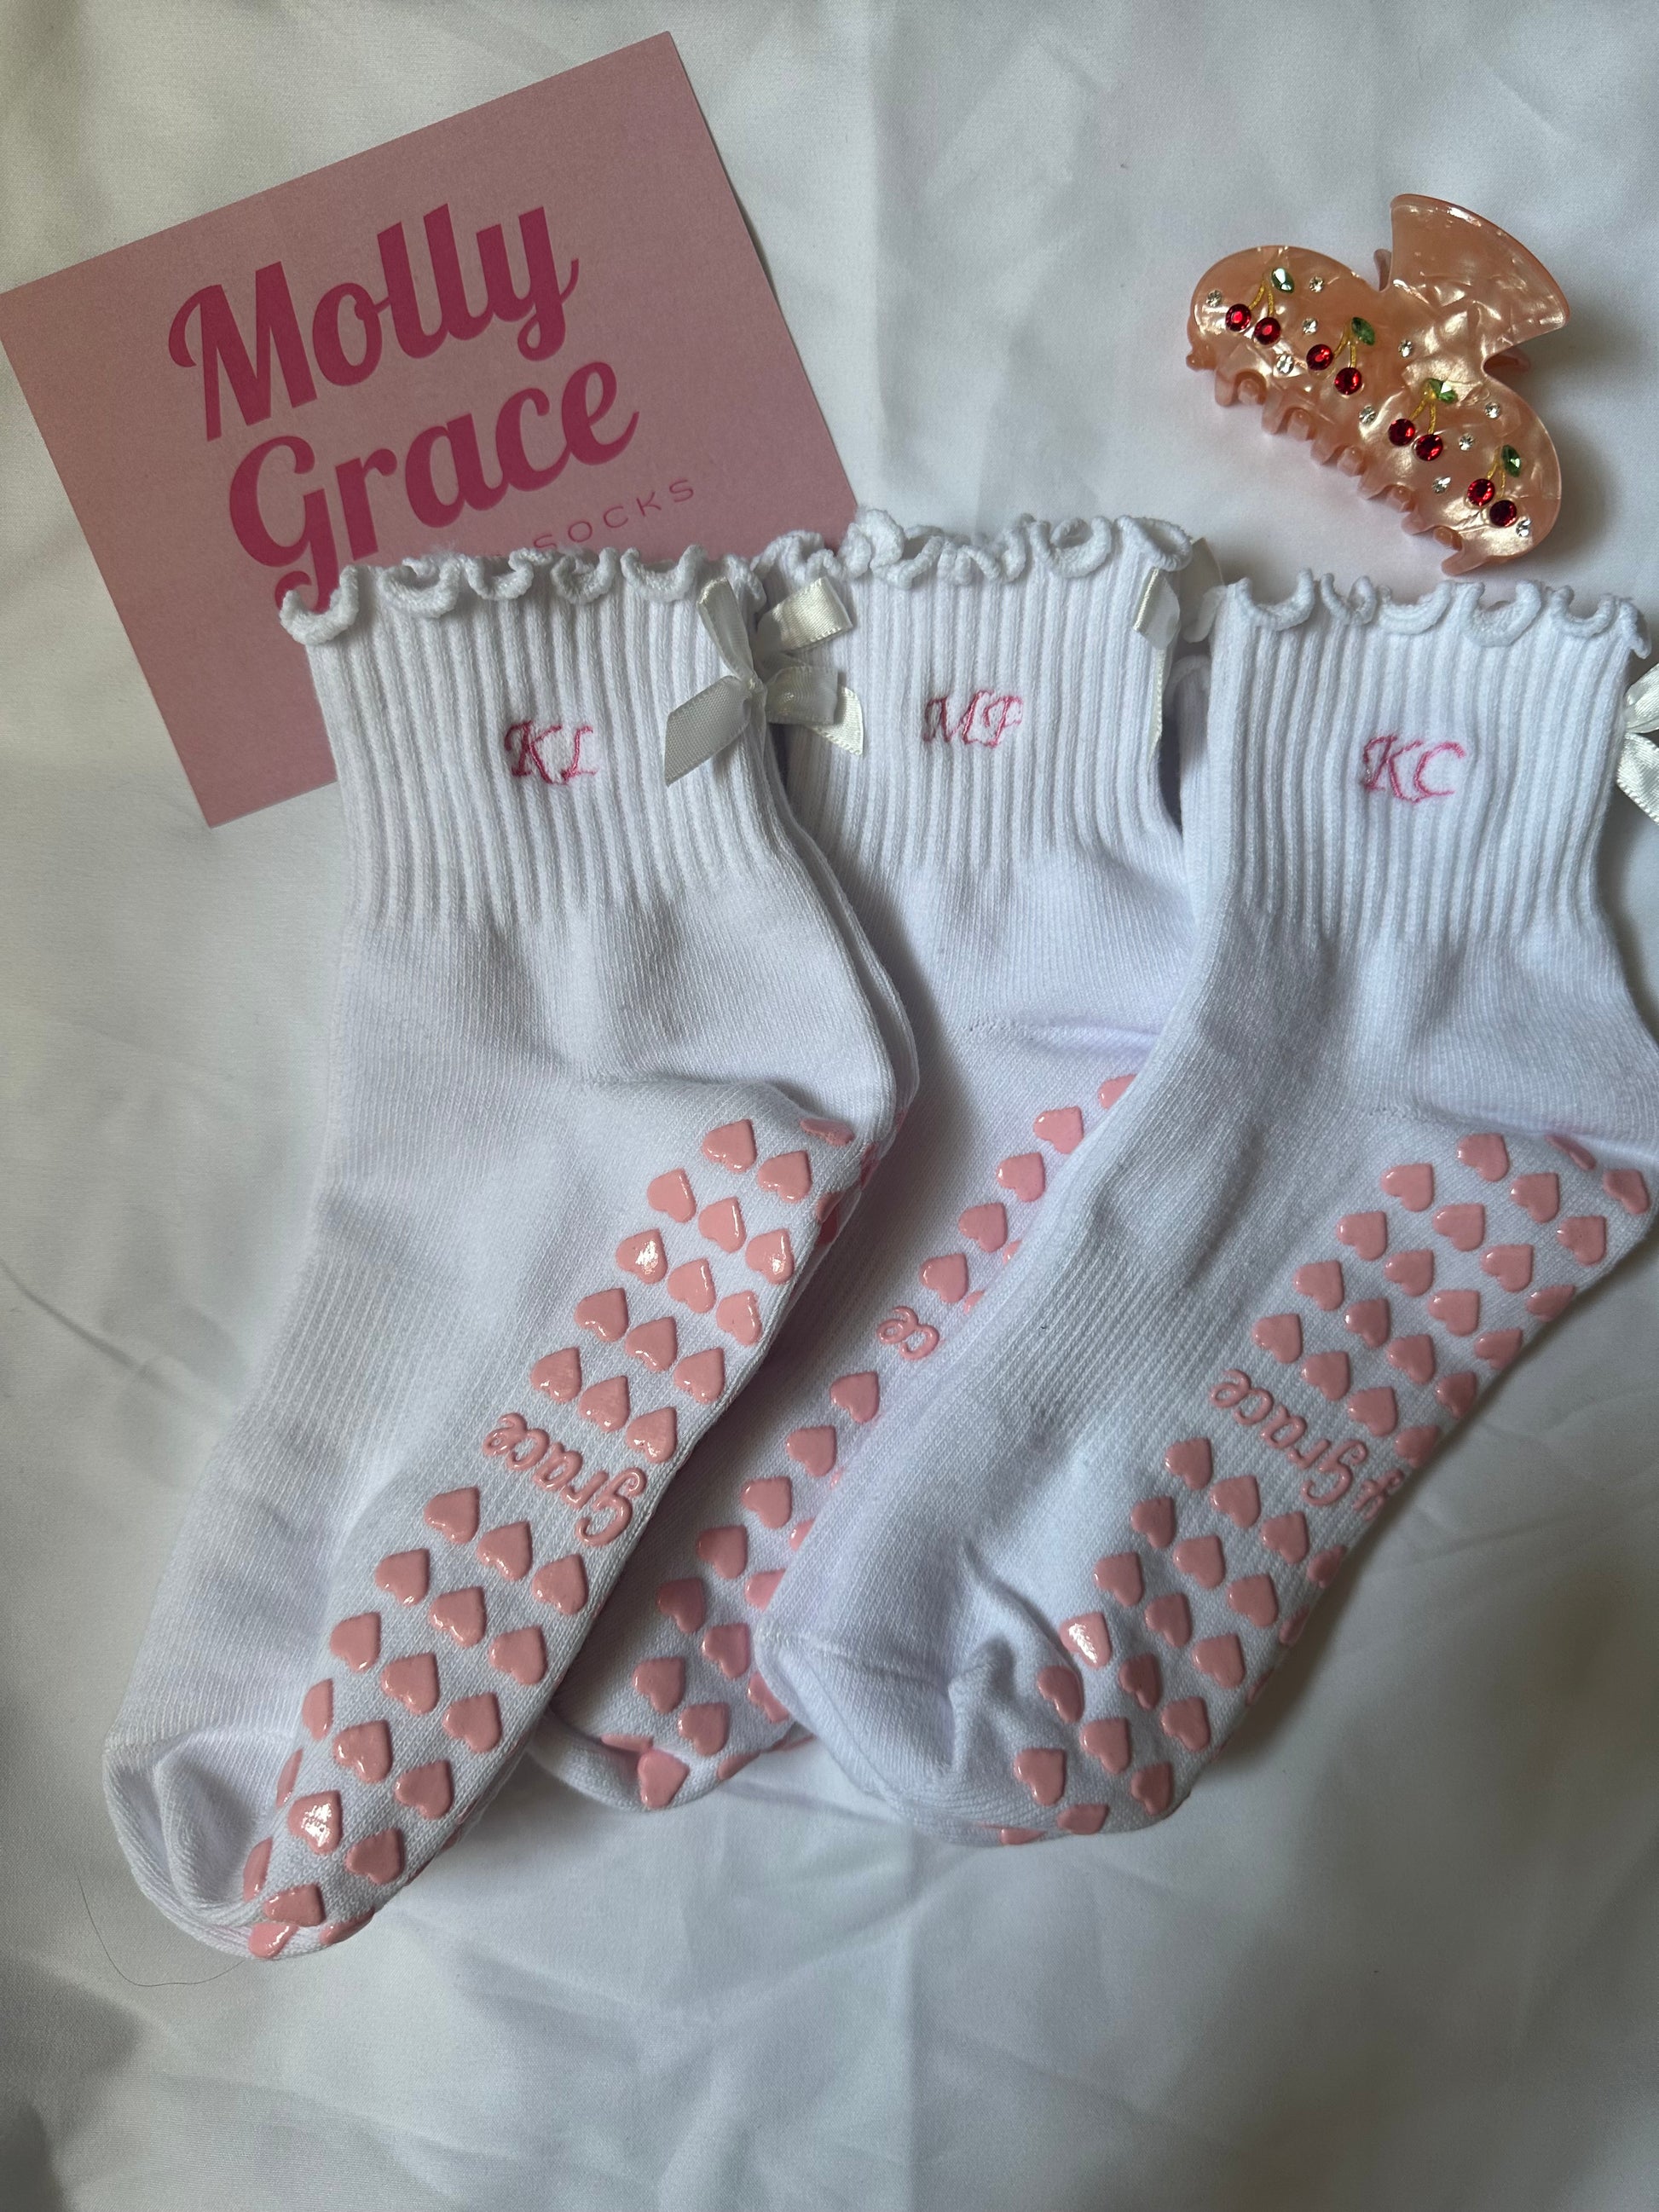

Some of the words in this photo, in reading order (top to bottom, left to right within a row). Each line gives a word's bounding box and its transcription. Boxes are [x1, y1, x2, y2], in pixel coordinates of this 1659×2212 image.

[169, 203, 579, 442] Molly
[229, 361, 639, 613] Grace
[533, 479, 695, 548] SOCKS
[1361, 733, 1465, 805] KC
